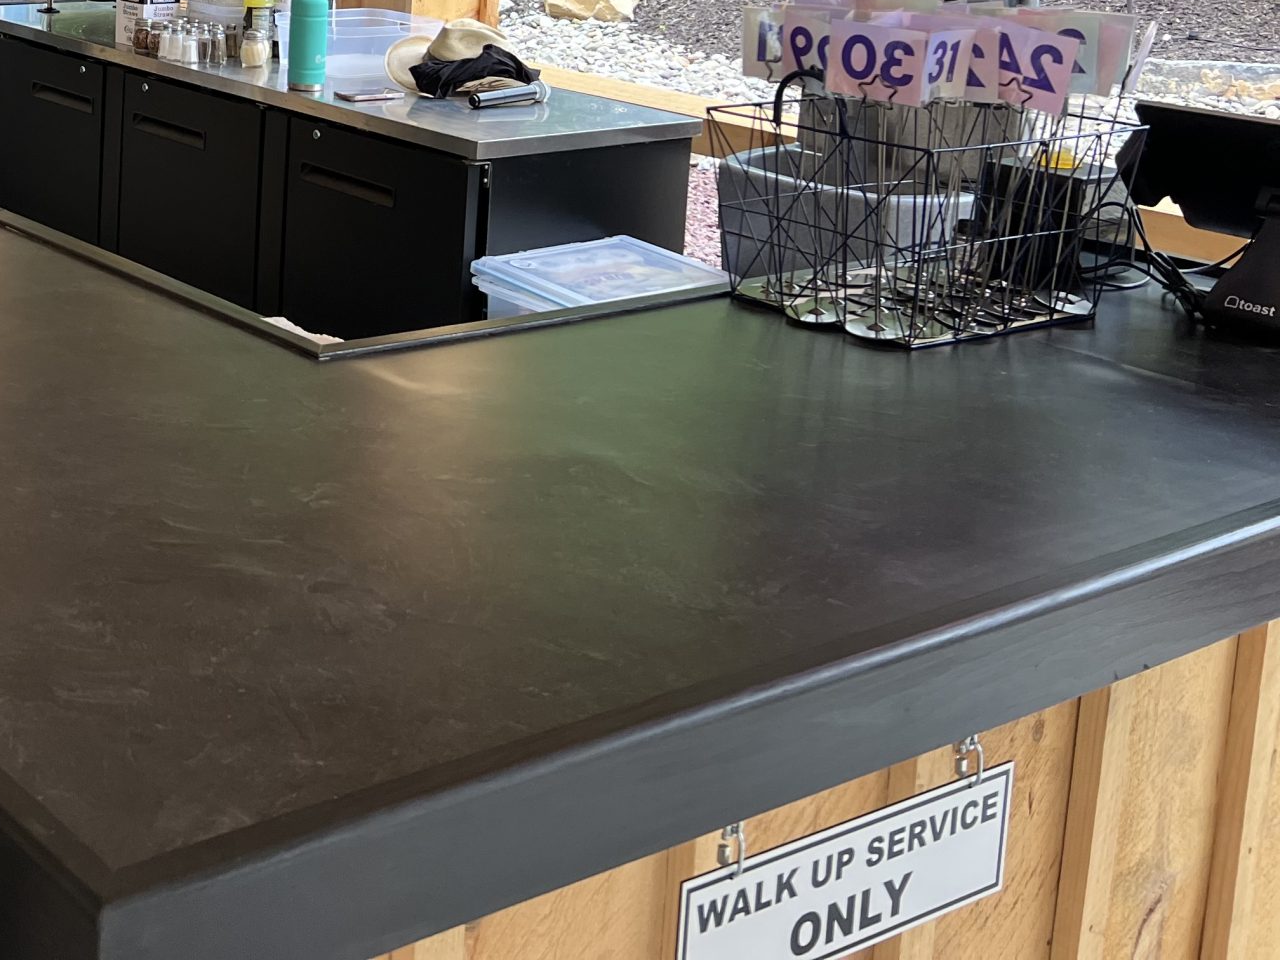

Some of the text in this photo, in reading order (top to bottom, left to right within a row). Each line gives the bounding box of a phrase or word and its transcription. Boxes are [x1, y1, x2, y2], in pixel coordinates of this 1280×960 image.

[928, 40, 961, 84] 31
[1239, 300, 1276, 317] toast
[697, 791, 999, 934] WALK UP SERVICE
[790, 871, 914, 956] ONLY
